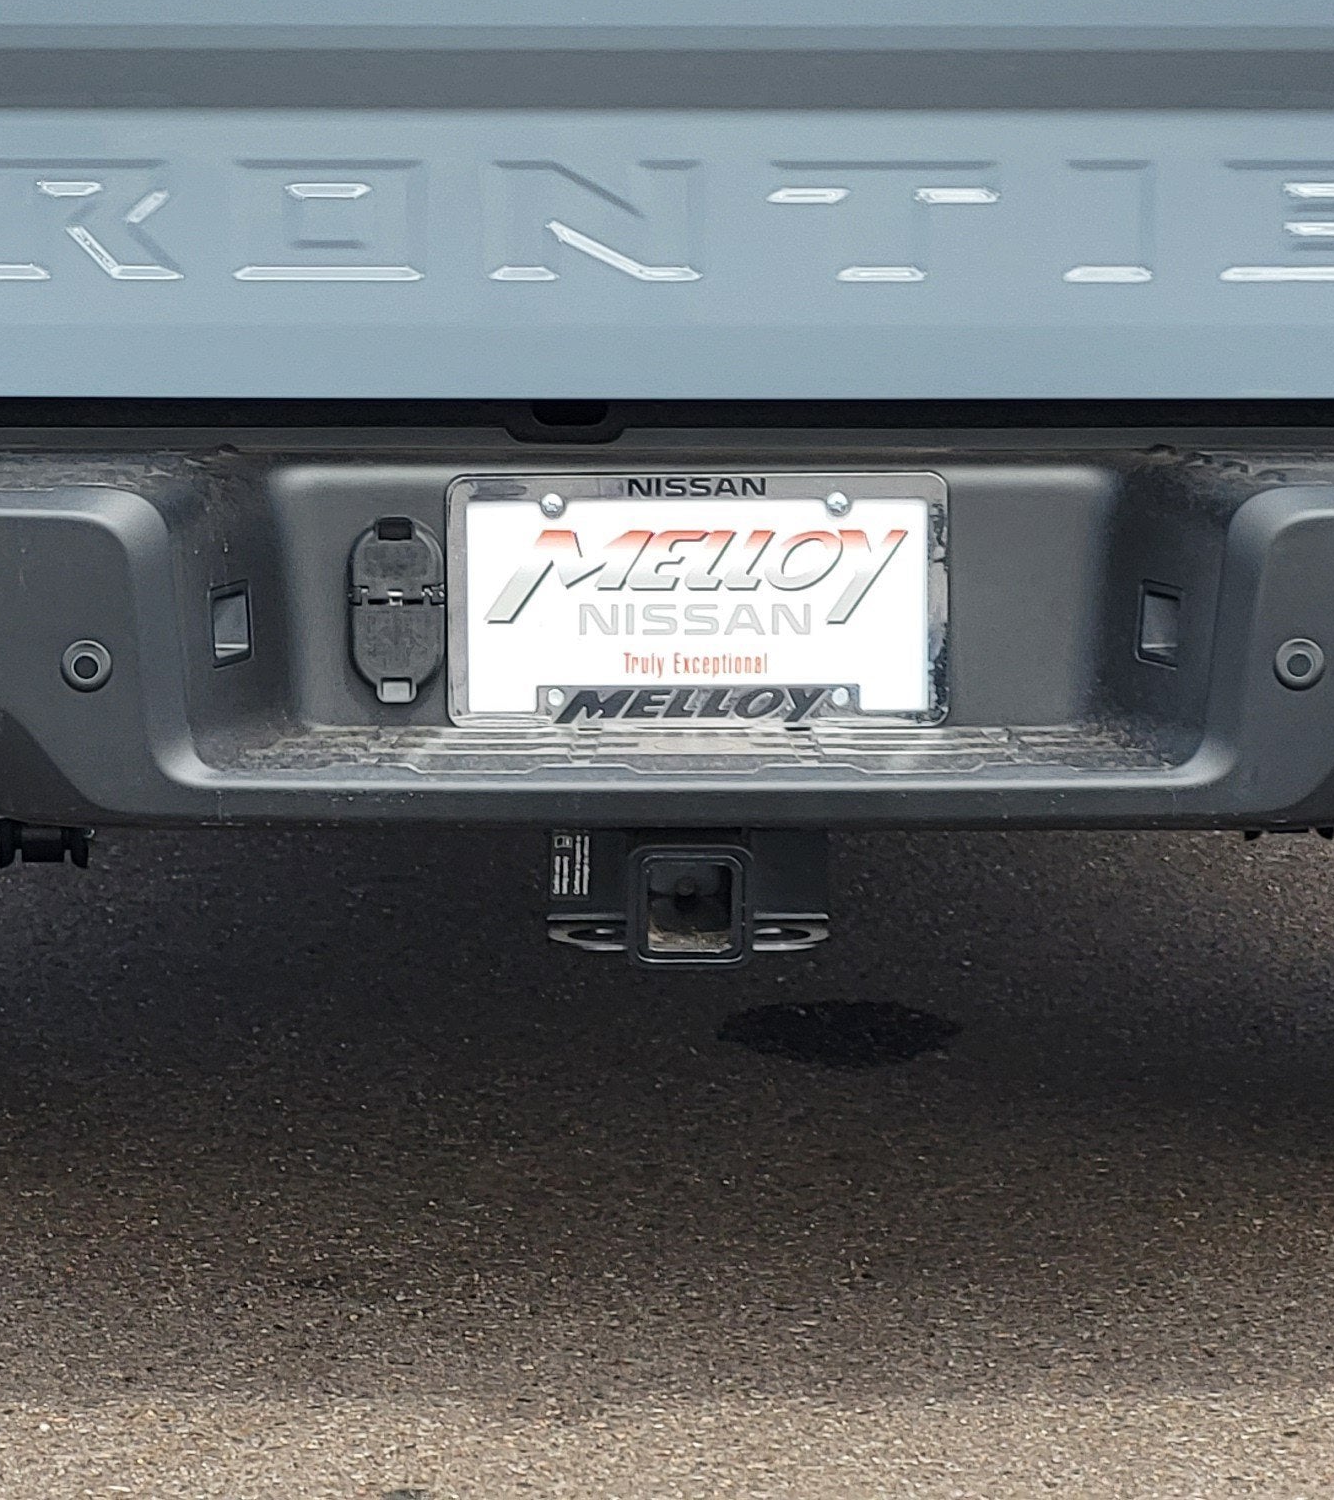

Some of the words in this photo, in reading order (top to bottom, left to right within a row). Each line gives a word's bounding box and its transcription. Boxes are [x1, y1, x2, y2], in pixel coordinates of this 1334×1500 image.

[627, 477, 767, 497] NISSAN
[483, 529, 910, 625] MELLOY
[578, 603, 812, 635] NISSAN
[623, 652, 664, 678] Truly
[674, 652, 768, 678] Exceptional
[553, 687, 826, 724] MELLOY
